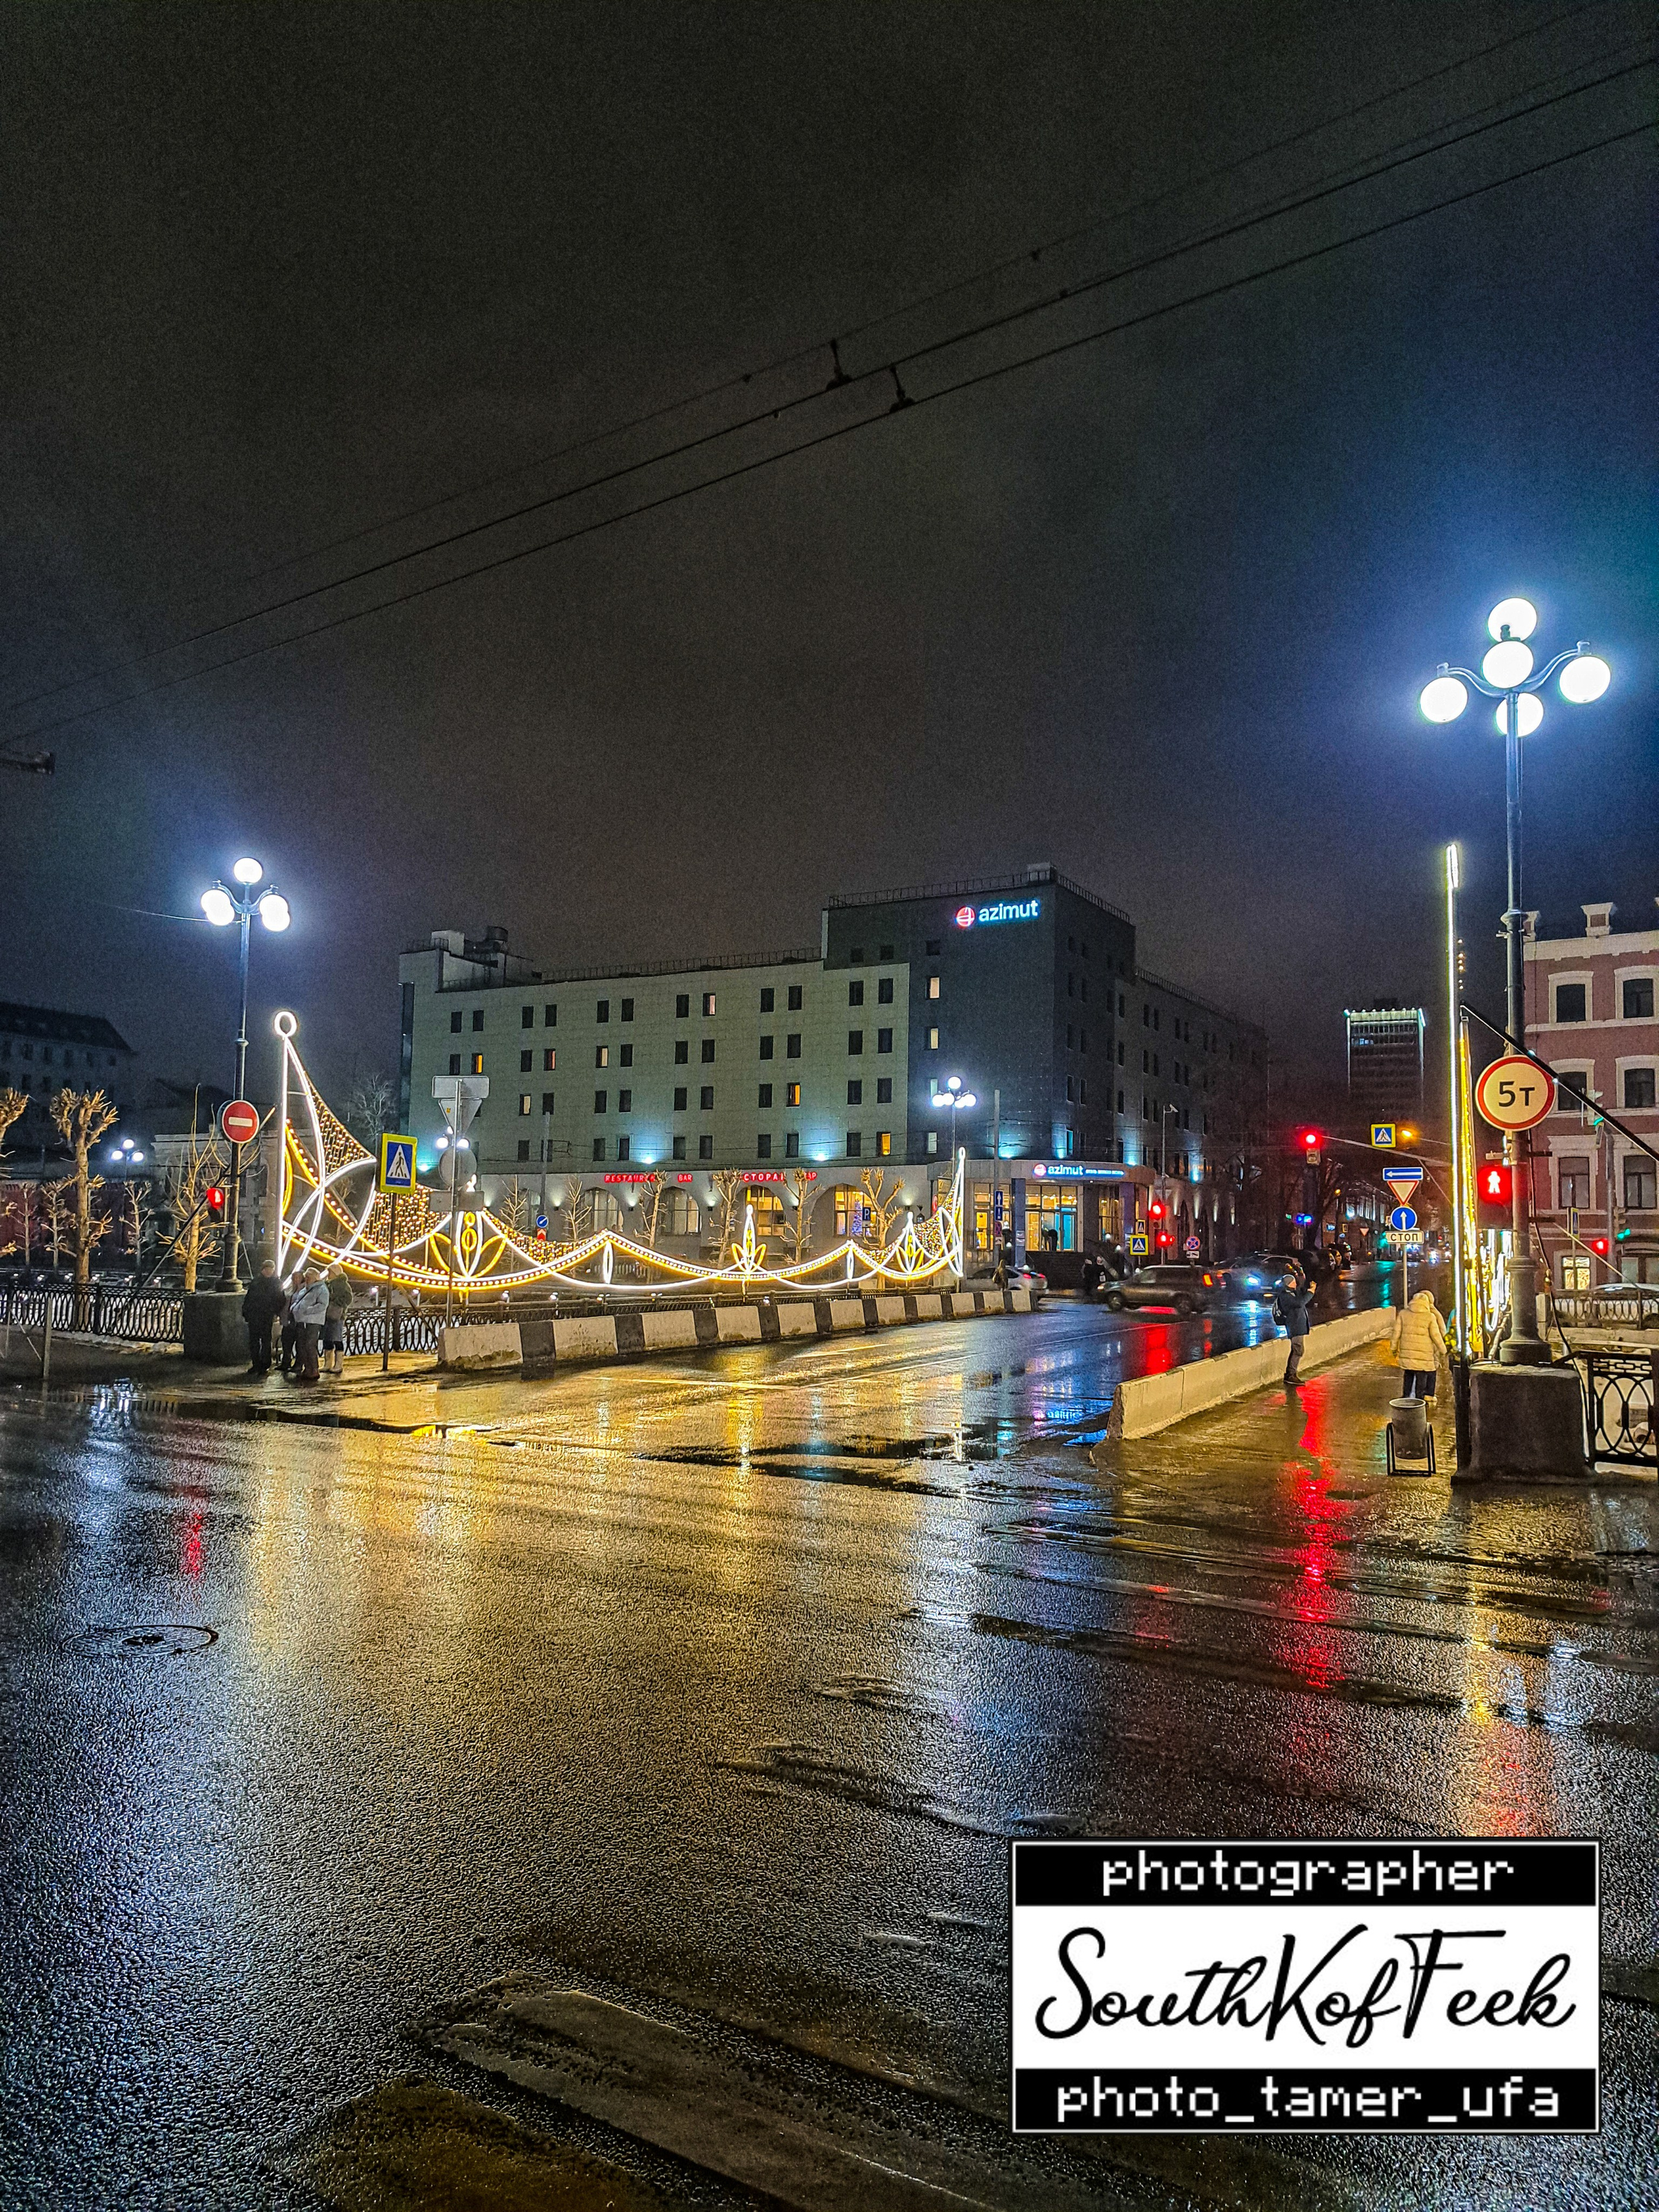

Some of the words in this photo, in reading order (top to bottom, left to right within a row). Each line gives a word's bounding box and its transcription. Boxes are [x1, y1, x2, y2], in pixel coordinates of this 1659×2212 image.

[979, 900, 1038, 922] azimut
[1047, 1164, 1084, 1176] azimut
[678, 1174, 693, 1182] BAR
[1390, 1233, 1418, 1241] СТОП
